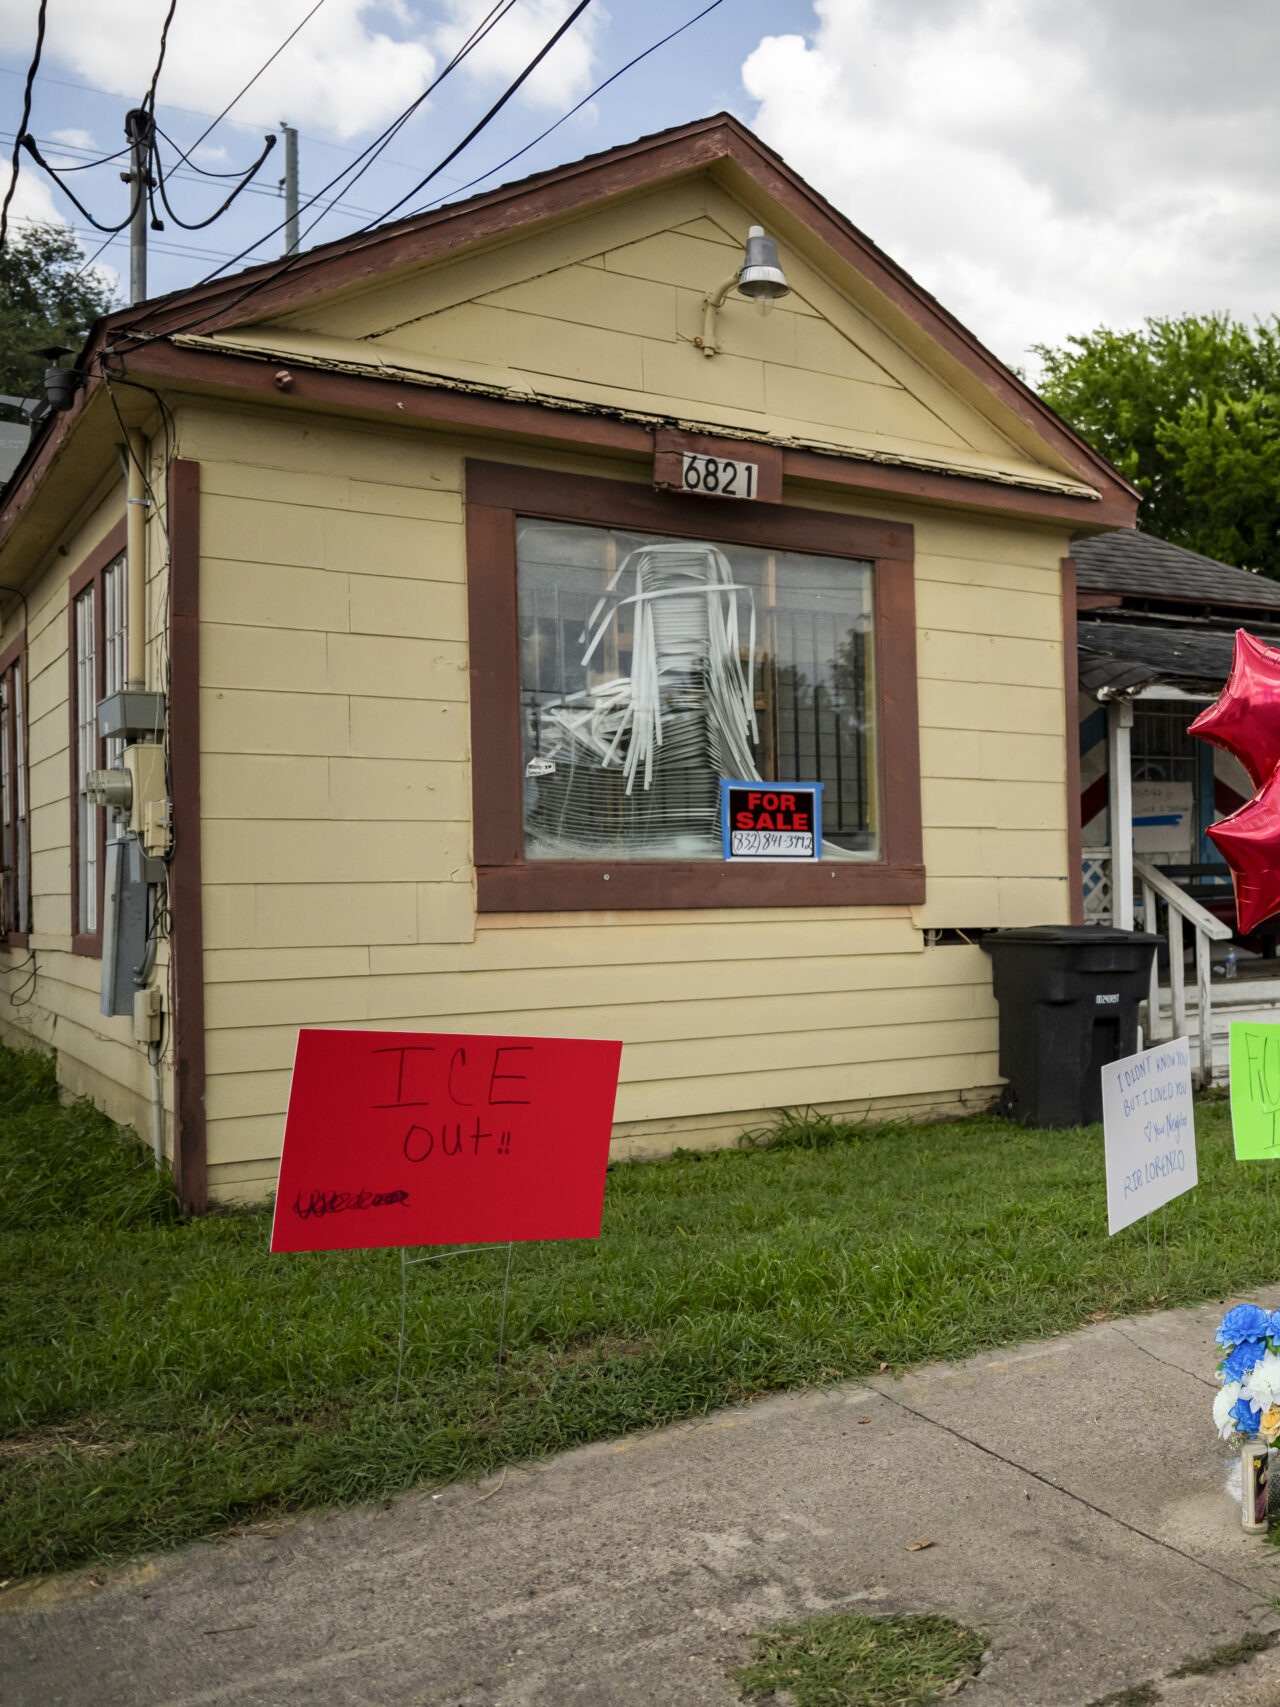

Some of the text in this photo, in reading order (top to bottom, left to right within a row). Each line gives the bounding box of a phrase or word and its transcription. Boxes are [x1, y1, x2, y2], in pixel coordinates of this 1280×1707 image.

[684, 455, 753, 498] 6821
[748, 792, 796, 811] FOR
[736, 811, 808, 831] SALE
[370, 1046, 534, 1109] ICE
[1117, 1072, 1124, 1093] I
[1124, 1081, 1187, 1117] BUT I LOVED YOU
[1145, 1150, 1185, 1184] LORENZO
